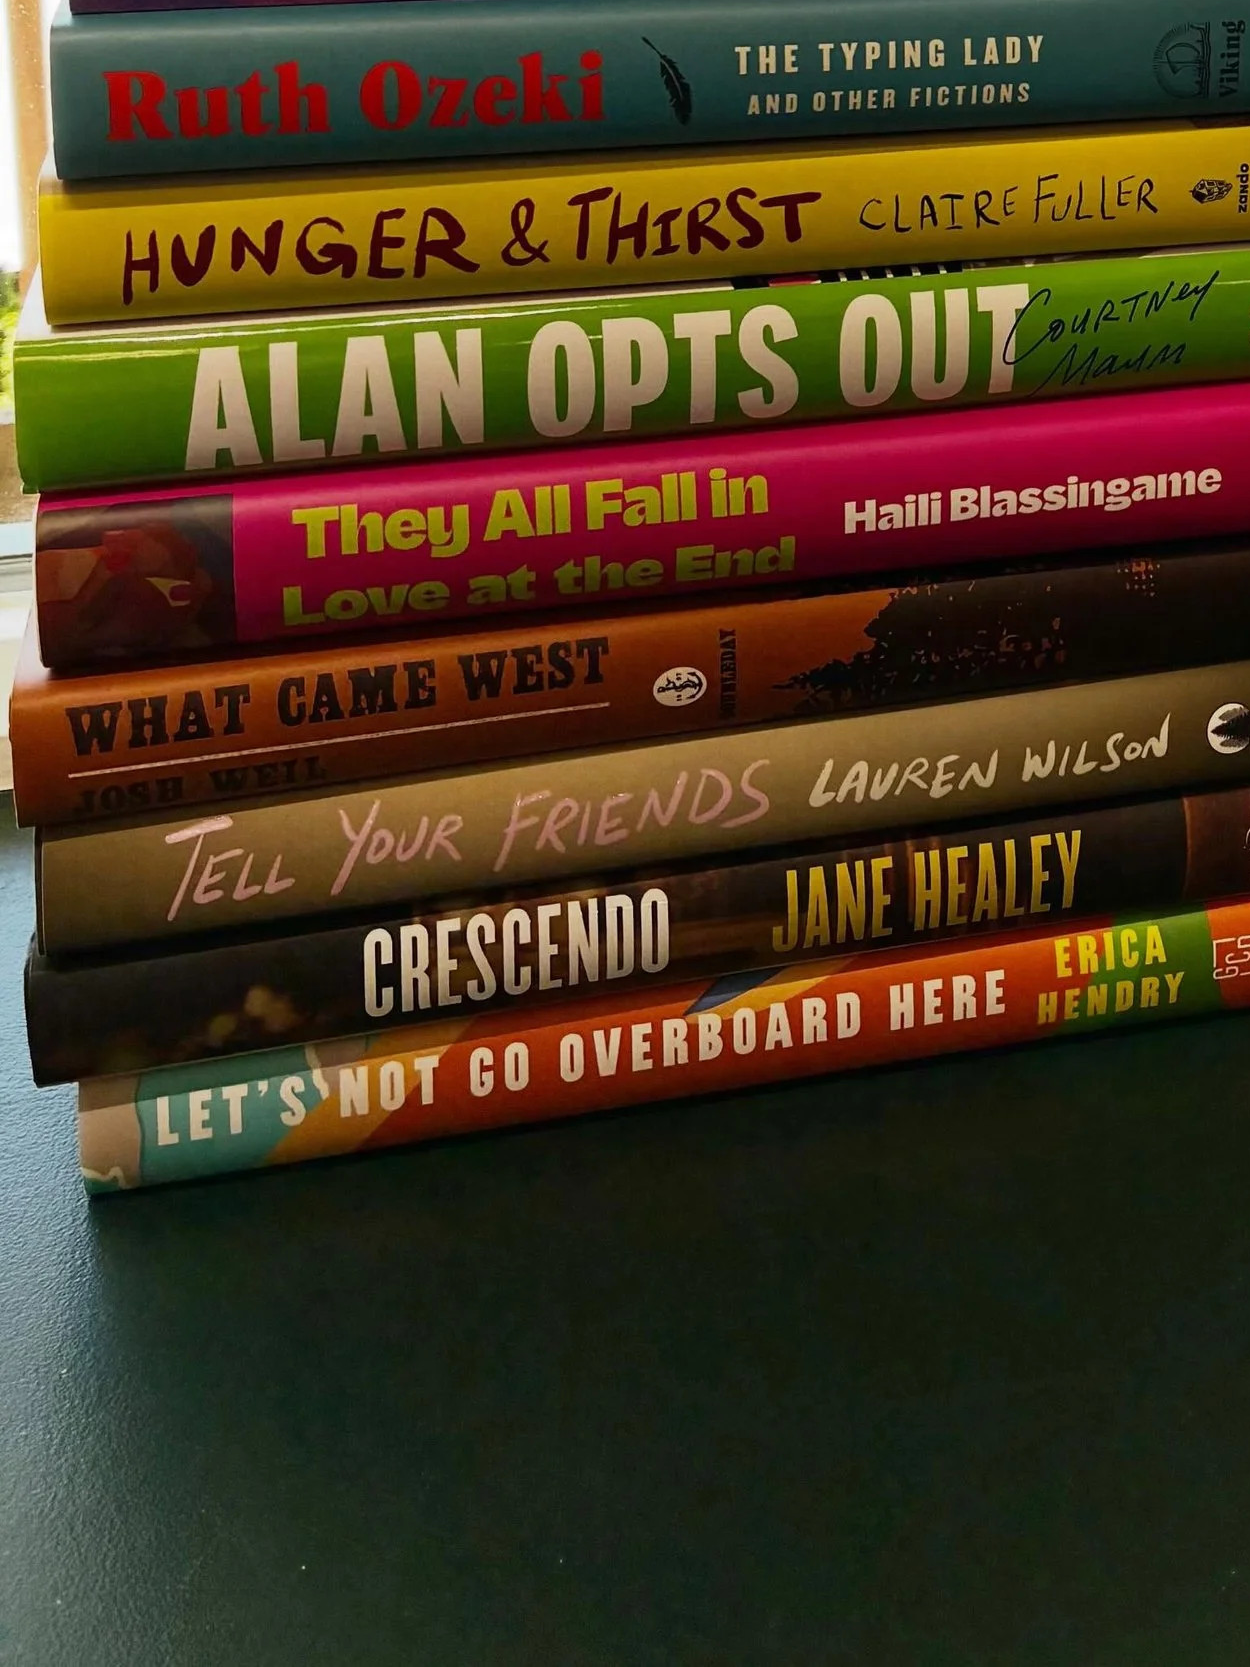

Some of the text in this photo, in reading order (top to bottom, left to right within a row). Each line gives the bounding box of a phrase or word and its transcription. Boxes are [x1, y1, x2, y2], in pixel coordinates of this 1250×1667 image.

[103, 49, 606, 142] Ruth Ozeki
[735, 35, 1044, 76] THE TYPING LADY
[747, 82, 1030, 117] AND OTHER FICTIONS
[1219, 20, 1245, 98] Viking
[859, 186, 1016, 233] CLAIRE
[1236, 163, 1249, 213] zando
[122, 186, 821, 305] HUNGER & THIRST
[185, 283, 1030, 472] ALAN OPTS OUT
[291, 467, 769, 560] They All Fall in
[844, 467, 1222, 534] Haili Blassingame
[281, 535, 797, 626] Love at the End
[65, 636, 610, 756] WHAT CAME WEST
[72, 755, 327, 816] JOSH WEIL
[808, 712, 1172, 809] LAUREN WILSON
[165, 760, 771, 921] TELL YOUR FRIENDS
[771, 829, 1082, 953] JANE HEALEY
[363, 887, 670, 1018] CRESCENDO
[1036, 970, 1185, 1025] HENDRY
[1054, 924, 1167, 979] ERICA
[339, 1055, 440, 1117] NOT
[469, 1041, 531, 1098] GO
[559, 992, 861, 1083] OVERBOARD
[888, 969, 1006, 1032] HERE
